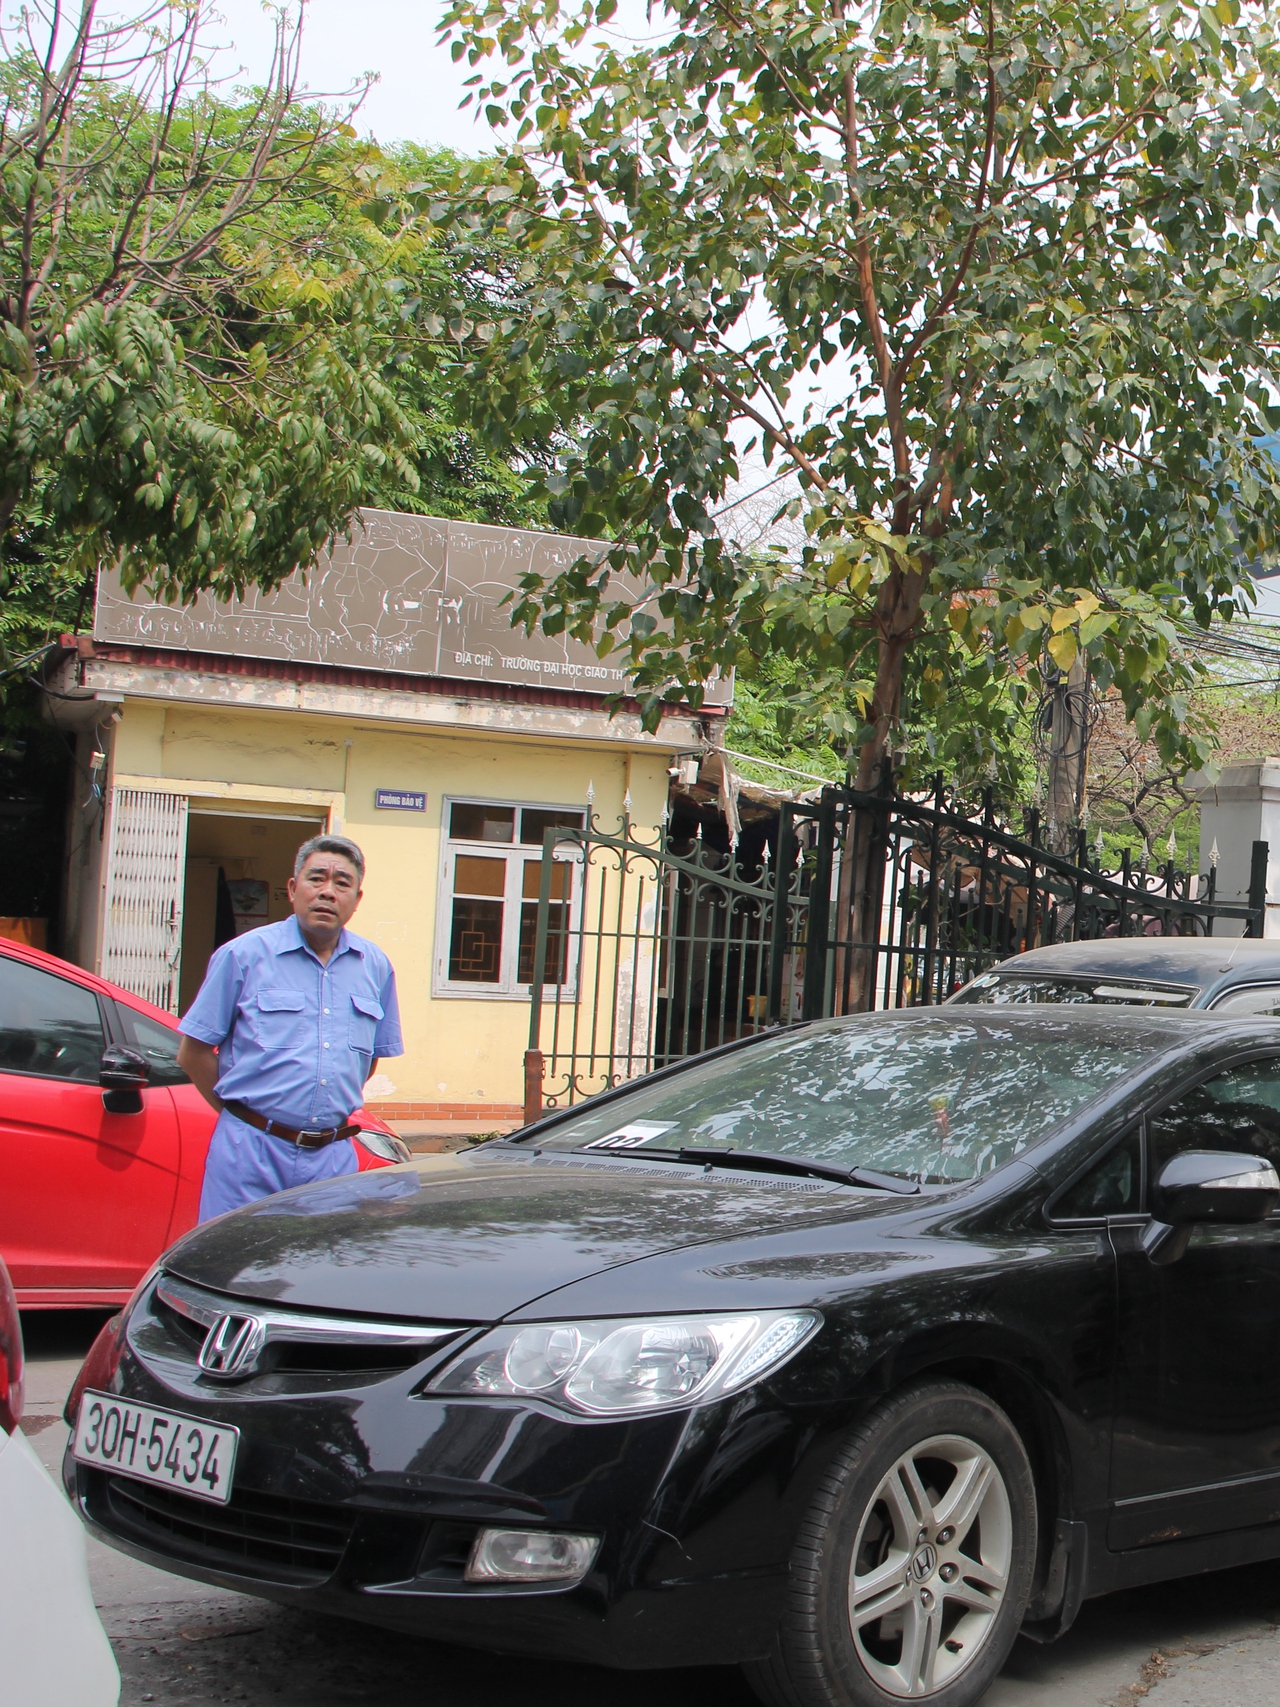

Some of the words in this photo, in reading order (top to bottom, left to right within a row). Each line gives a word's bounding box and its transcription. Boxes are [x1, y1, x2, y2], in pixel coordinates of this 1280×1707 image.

[455, 651, 472, 667] ĐỊA
[474, 650, 494, 667] CHỈ:
[500, 654, 541, 672] TRƯỜNG
[543, 662, 560, 677] ĐẠI
[561, 664, 582, 679] HỌC
[584, 665, 608, 679] GIAO
[379, 794, 401, 805] PHÒNG
[401, 794, 415, 807] BẢO
[415, 796, 424, 809] VỆ
